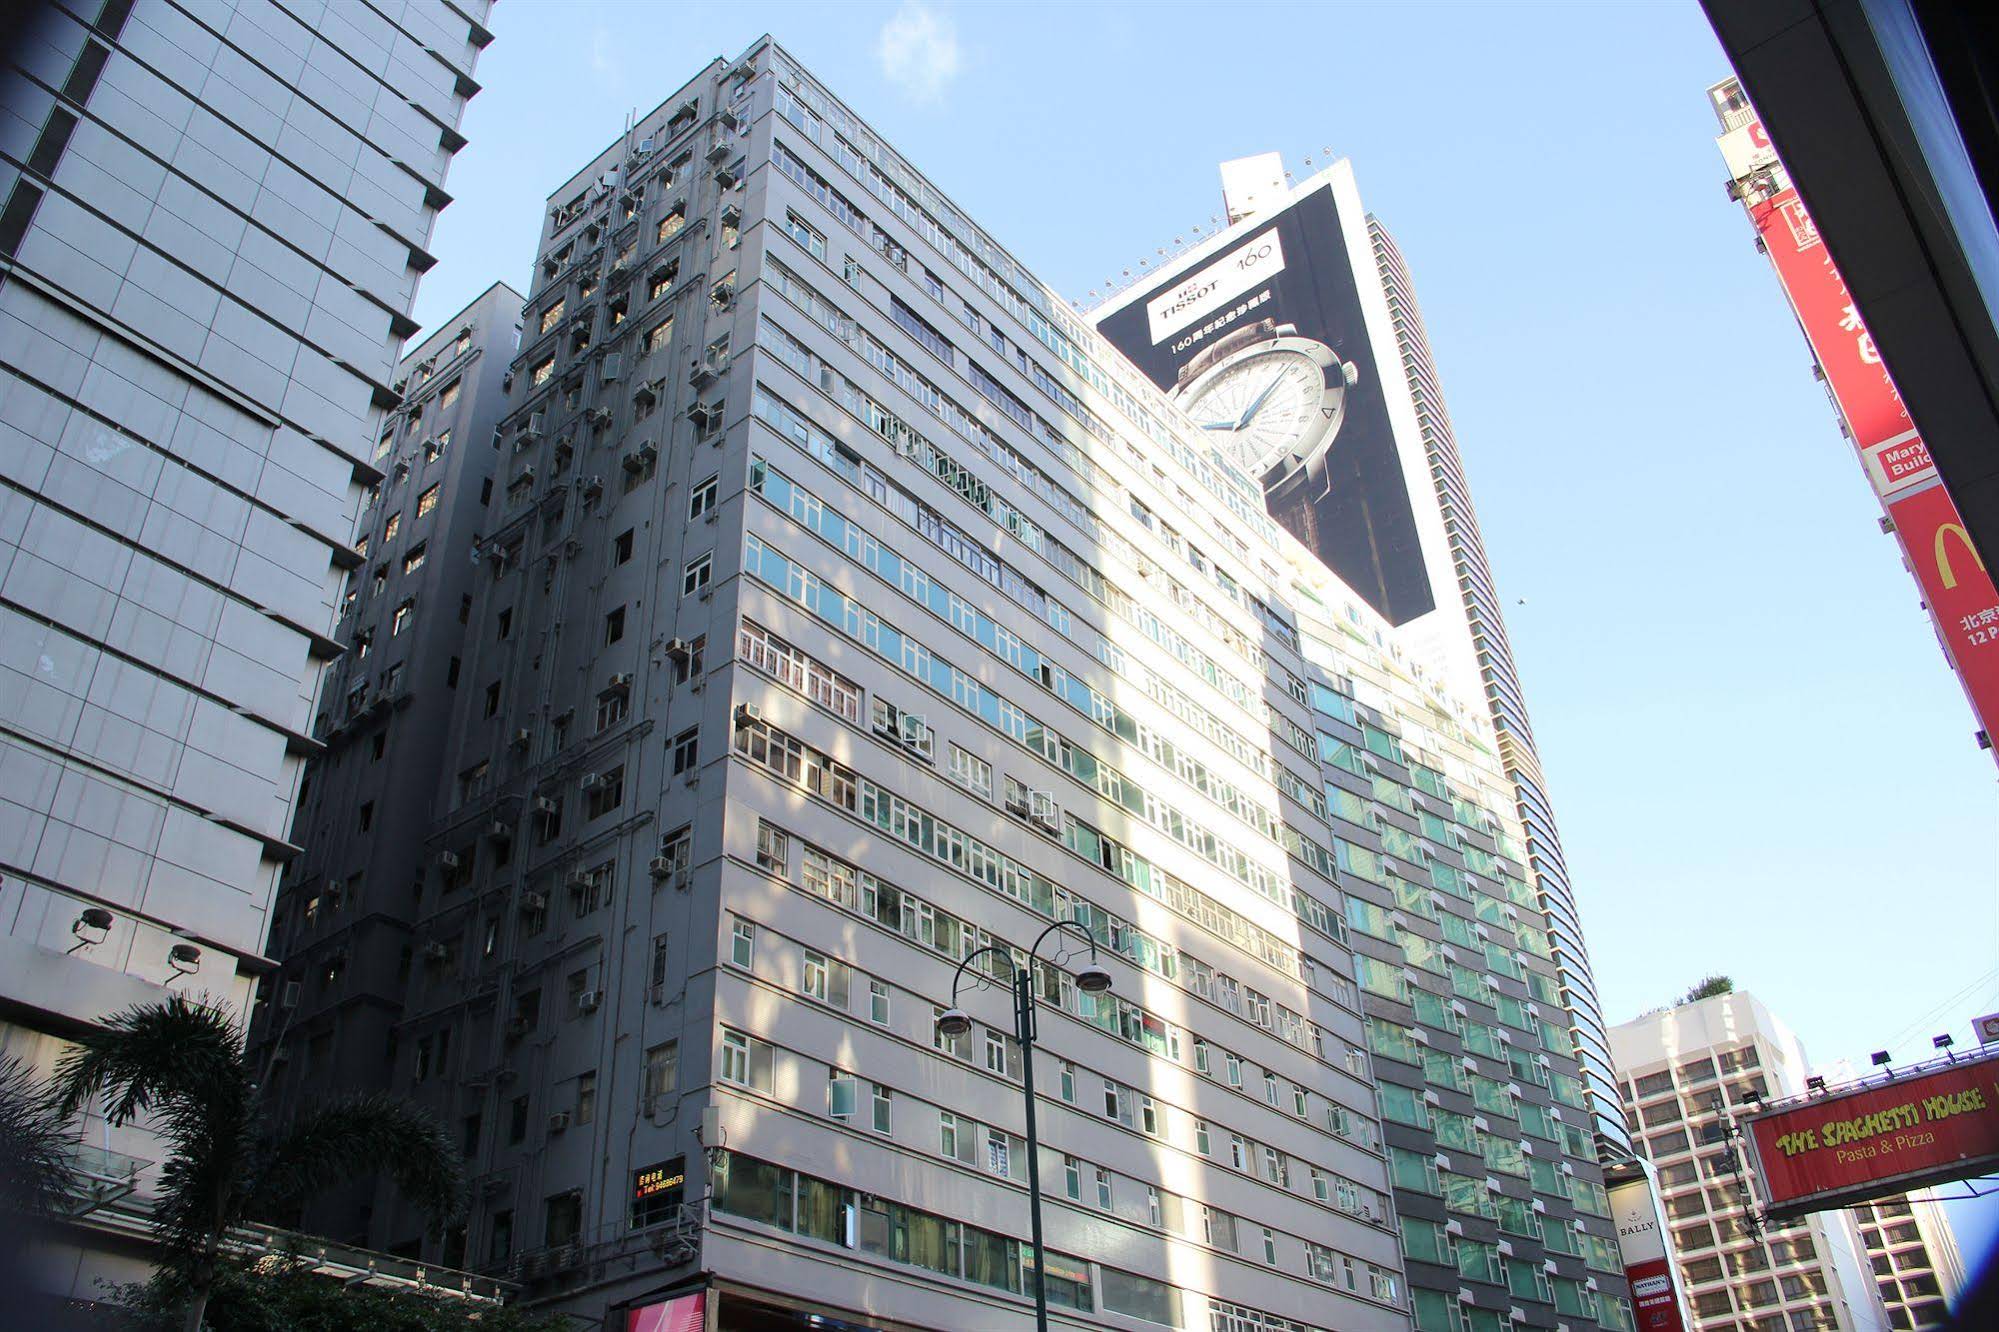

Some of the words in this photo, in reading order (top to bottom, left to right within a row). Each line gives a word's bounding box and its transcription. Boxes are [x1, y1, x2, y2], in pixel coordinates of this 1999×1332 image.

[1237, 244, 1272, 270] 160
[1160, 280, 1218, 319] TISSOT
[1885, 442, 1924, 464] Mary
[1960, 605, 1999, 631] 北京
[1968, 631, 1987, 646] 12
[1987, 626, 1999, 639] P
[1776, 1129, 1819, 1157] THE
[1821, 1102, 1919, 1147] SPAGHETTI
[1922, 1087, 1987, 1121] HOUSE
[1836, 1144, 1875, 1164] Pasta
[1880, 1139, 1893, 1154] &
[1896, 1131, 1935, 1151] Pizza
[1620, 1221, 1654, 1236] BALLY
